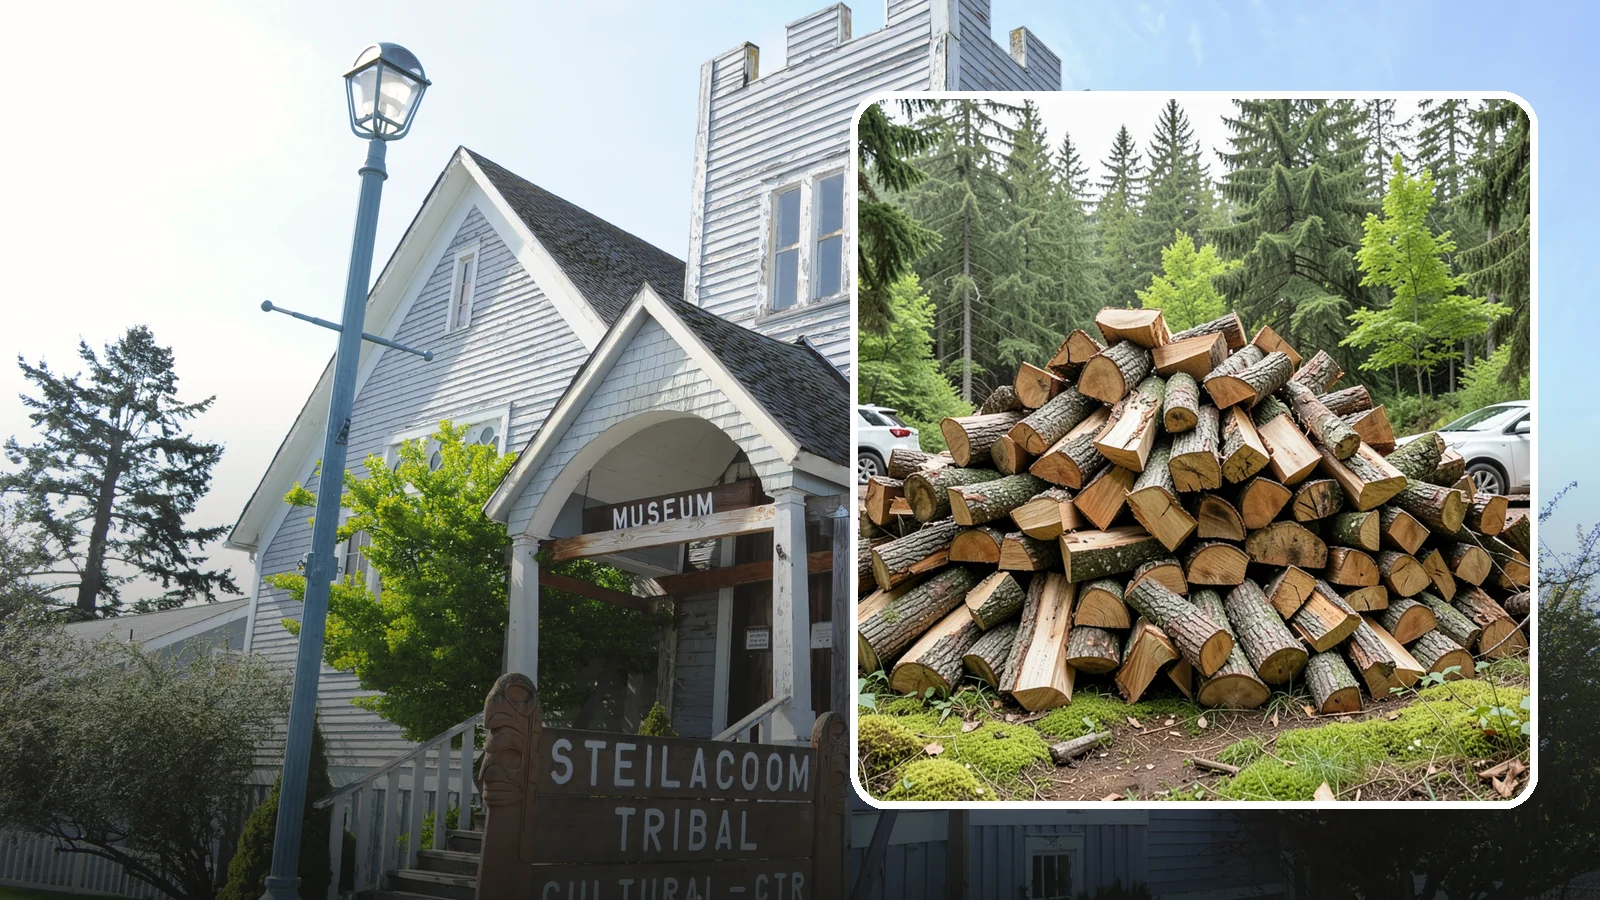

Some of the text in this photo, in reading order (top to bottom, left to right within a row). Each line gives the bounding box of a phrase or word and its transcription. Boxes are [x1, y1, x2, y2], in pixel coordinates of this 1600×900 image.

[613, 491, 714, 531] MUSEUM
[550, 738, 809, 793] STEILACOOM
[615, 806, 757, 852] TRIBAL
